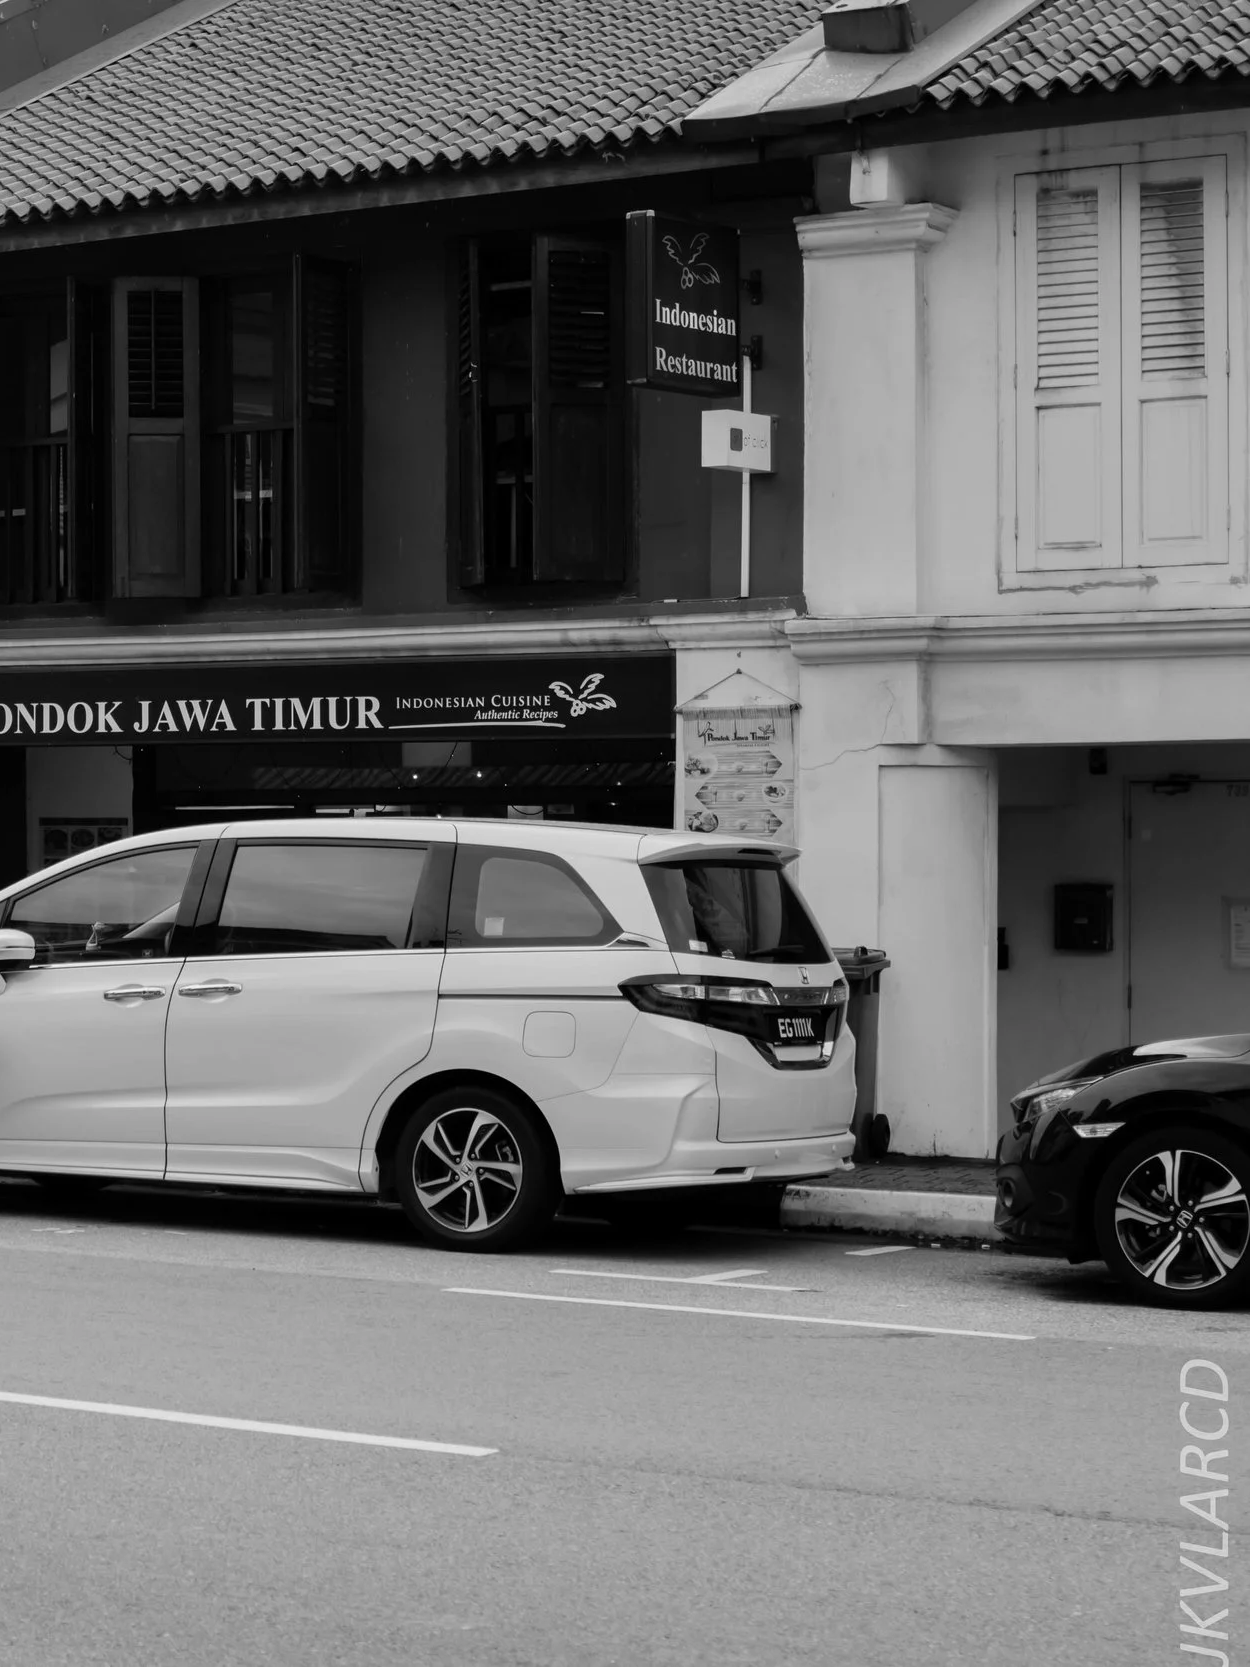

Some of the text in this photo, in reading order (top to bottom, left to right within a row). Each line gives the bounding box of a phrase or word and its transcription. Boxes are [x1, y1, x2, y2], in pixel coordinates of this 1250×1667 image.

[654, 298, 737, 336] Indonesian
[654, 346, 738, 383] Restaurant
[133, 699, 237, 733] JAWA
[245, 696, 384, 731] TIMUR
[396, 694, 551, 709] INDONESIAN CUISINE
[474, 708, 558, 721] Authentic Recipes
[778, 1018, 814, 1038] EG1111K
